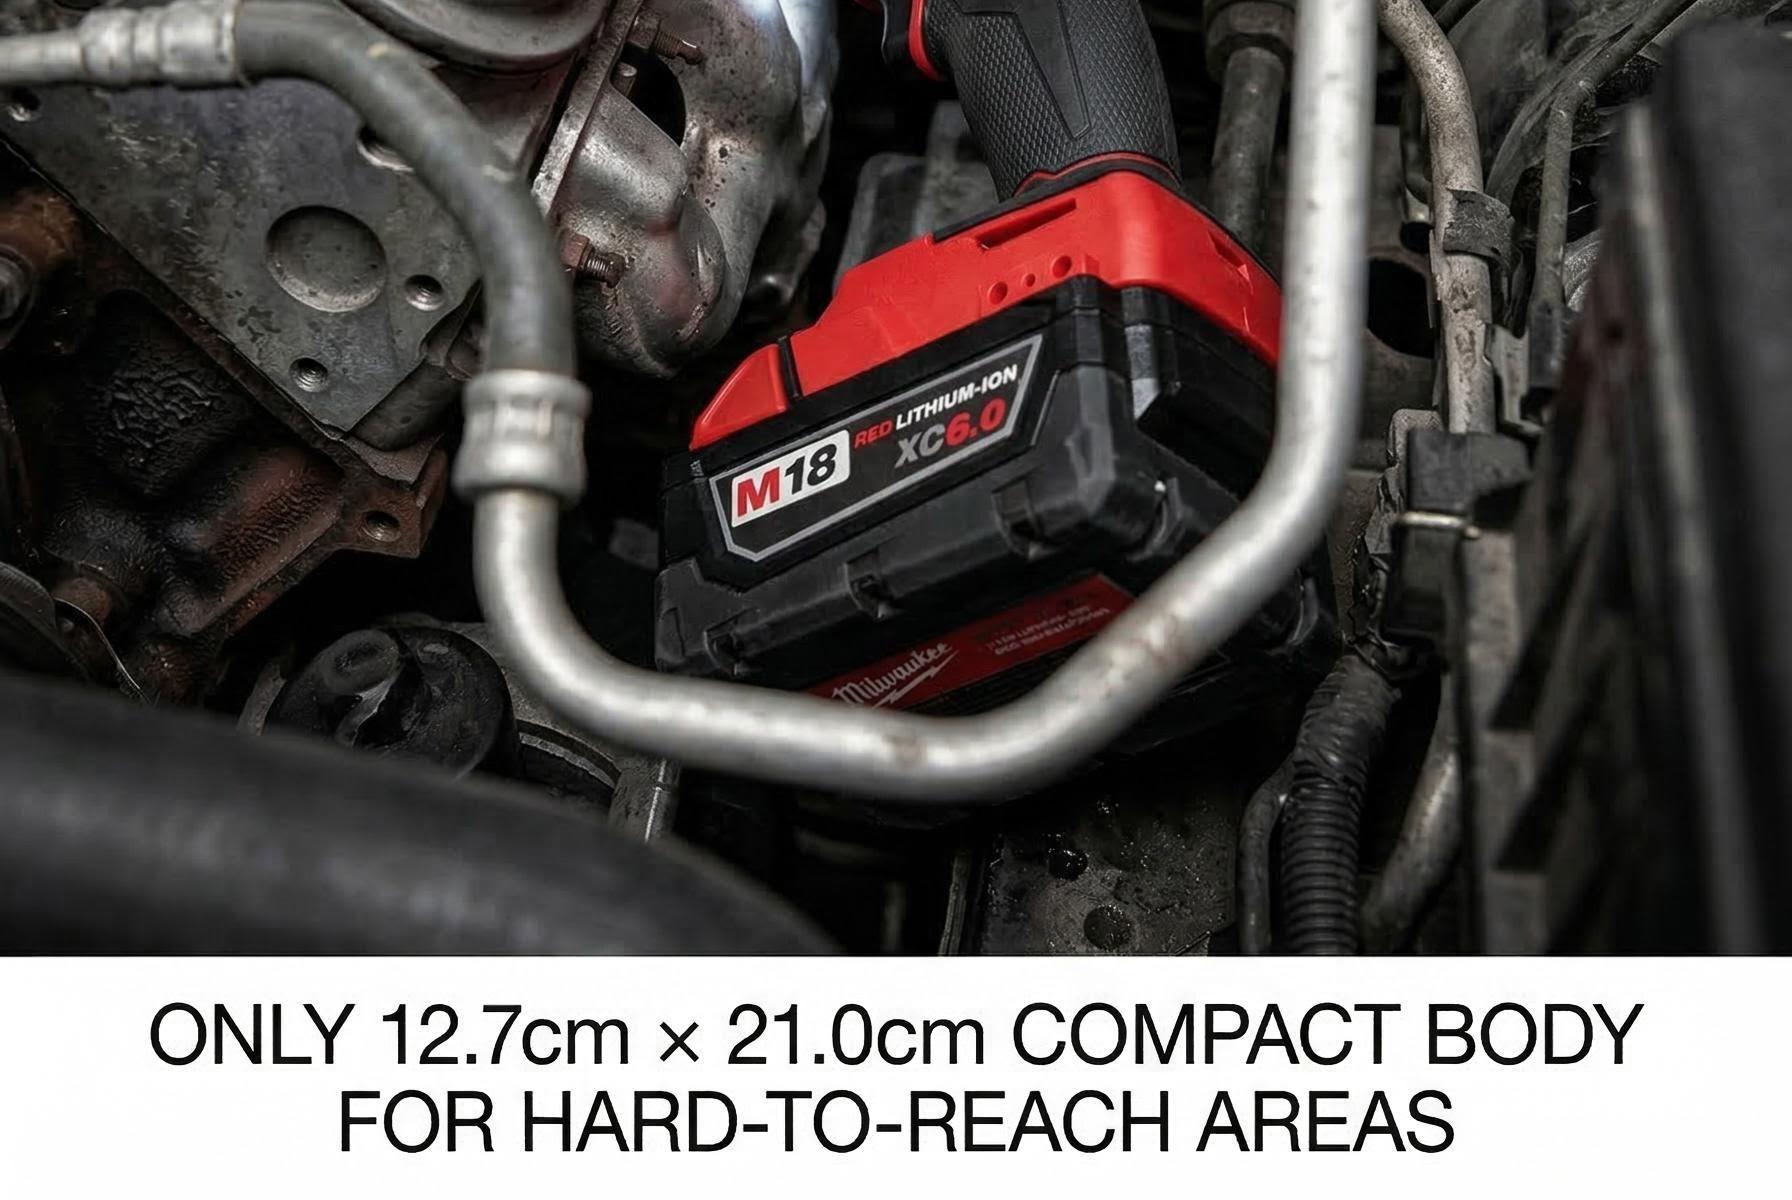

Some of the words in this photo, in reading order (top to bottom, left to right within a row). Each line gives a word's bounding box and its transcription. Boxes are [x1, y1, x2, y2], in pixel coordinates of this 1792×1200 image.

[854, 419, 894, 449] RED
[895, 364, 1019, 431] LITHIUM-ION
[895, 397, 1007, 469] XC6.0
[736, 443, 838, 518] M18
[832, 642, 953, 706] Milwaukee
